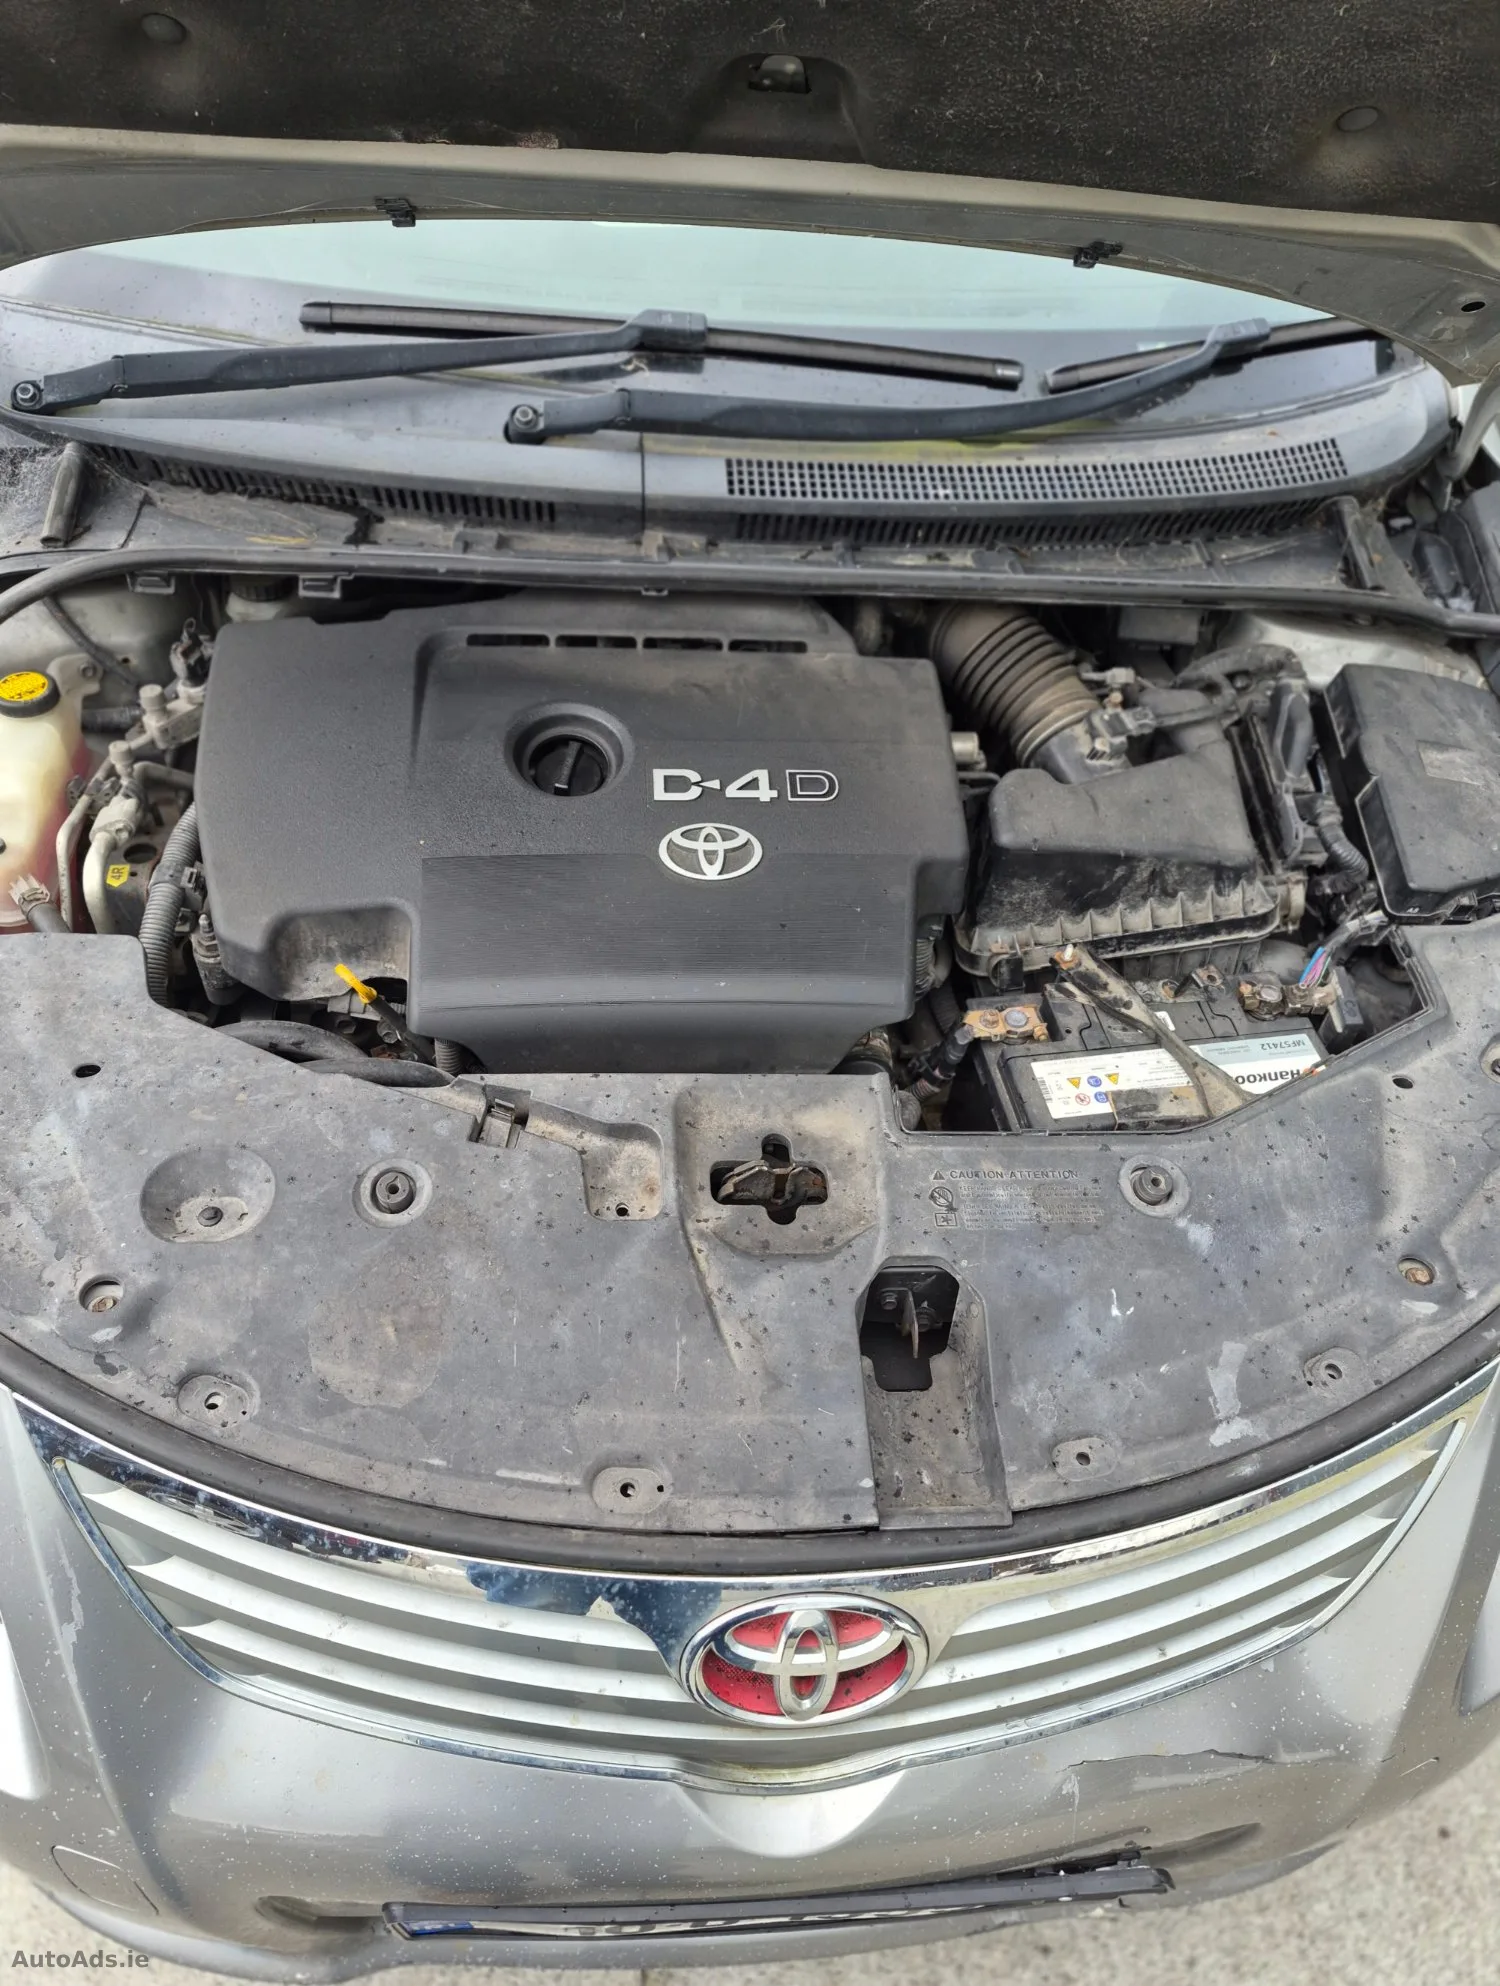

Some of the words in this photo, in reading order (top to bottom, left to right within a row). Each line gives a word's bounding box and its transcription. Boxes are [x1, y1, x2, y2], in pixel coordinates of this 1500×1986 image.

[652, 768, 839, 802] D-4D
[1260, 1039, 1306, 1051] MF57412
[1234, 1068, 1301, 1085] Hankoo
[949, 1169, 1004, 1180] CAUTION
[1008, 1169, 1079, 1180] ATTENTION
